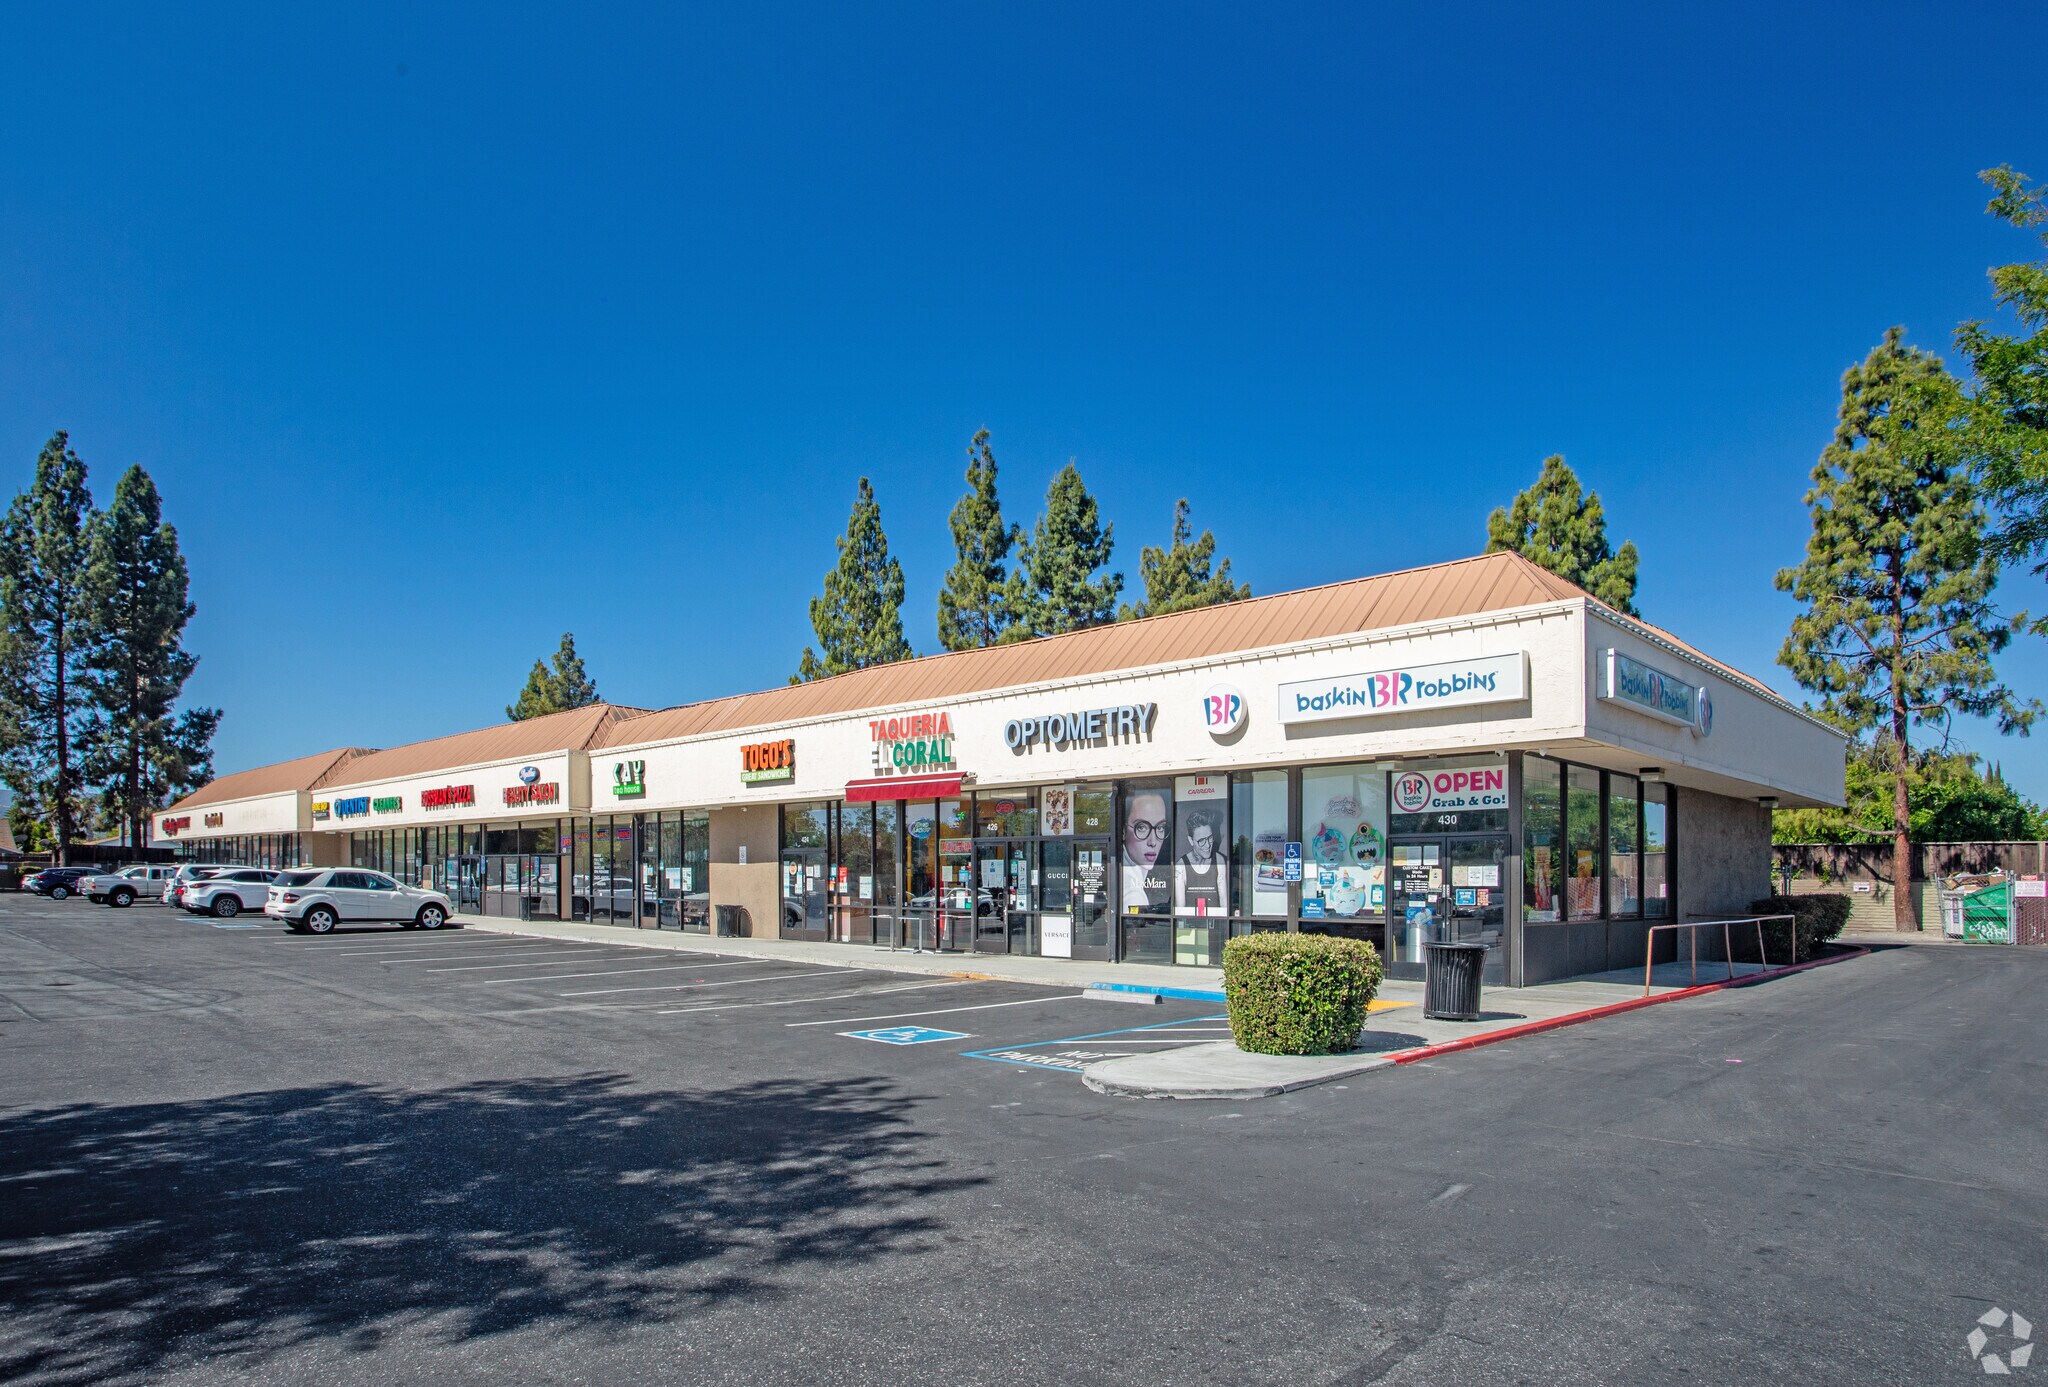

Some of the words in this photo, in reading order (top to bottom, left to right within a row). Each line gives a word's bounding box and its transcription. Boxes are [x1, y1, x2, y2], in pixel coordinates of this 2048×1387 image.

[1296, 687, 1366, 712] baskin
[1367, 671, 1413, 708] BR
[1416, 671, 1497, 698] robbins
[1620, 669, 1649, 700] baskin
[1665, 690, 1689, 716] robbins
[1203, 694, 1241, 726] BR
[869, 711, 950, 742] TAQUERIA
[1004, 702, 1156, 749] OPTOMETRY
[740, 738, 791, 771] TOGO'S
[893, 738, 951, 767] CORAL
[530, 782, 555, 801] SALON
[1187, 787, 1215, 795] CARRERA
[1434, 769, 1503, 794] OPEN
[454, 784, 472, 803] PIZZA
[1432, 797, 1465, 807] Grab
[1468, 796, 1479, 806] &
[1482, 794, 1506, 805] Go!
[341, 796, 370, 815] DENTIST
[987, 823, 998, 831] 426
[1086, 818, 1099, 826] 428
[1438, 814, 1457, 825] 430
